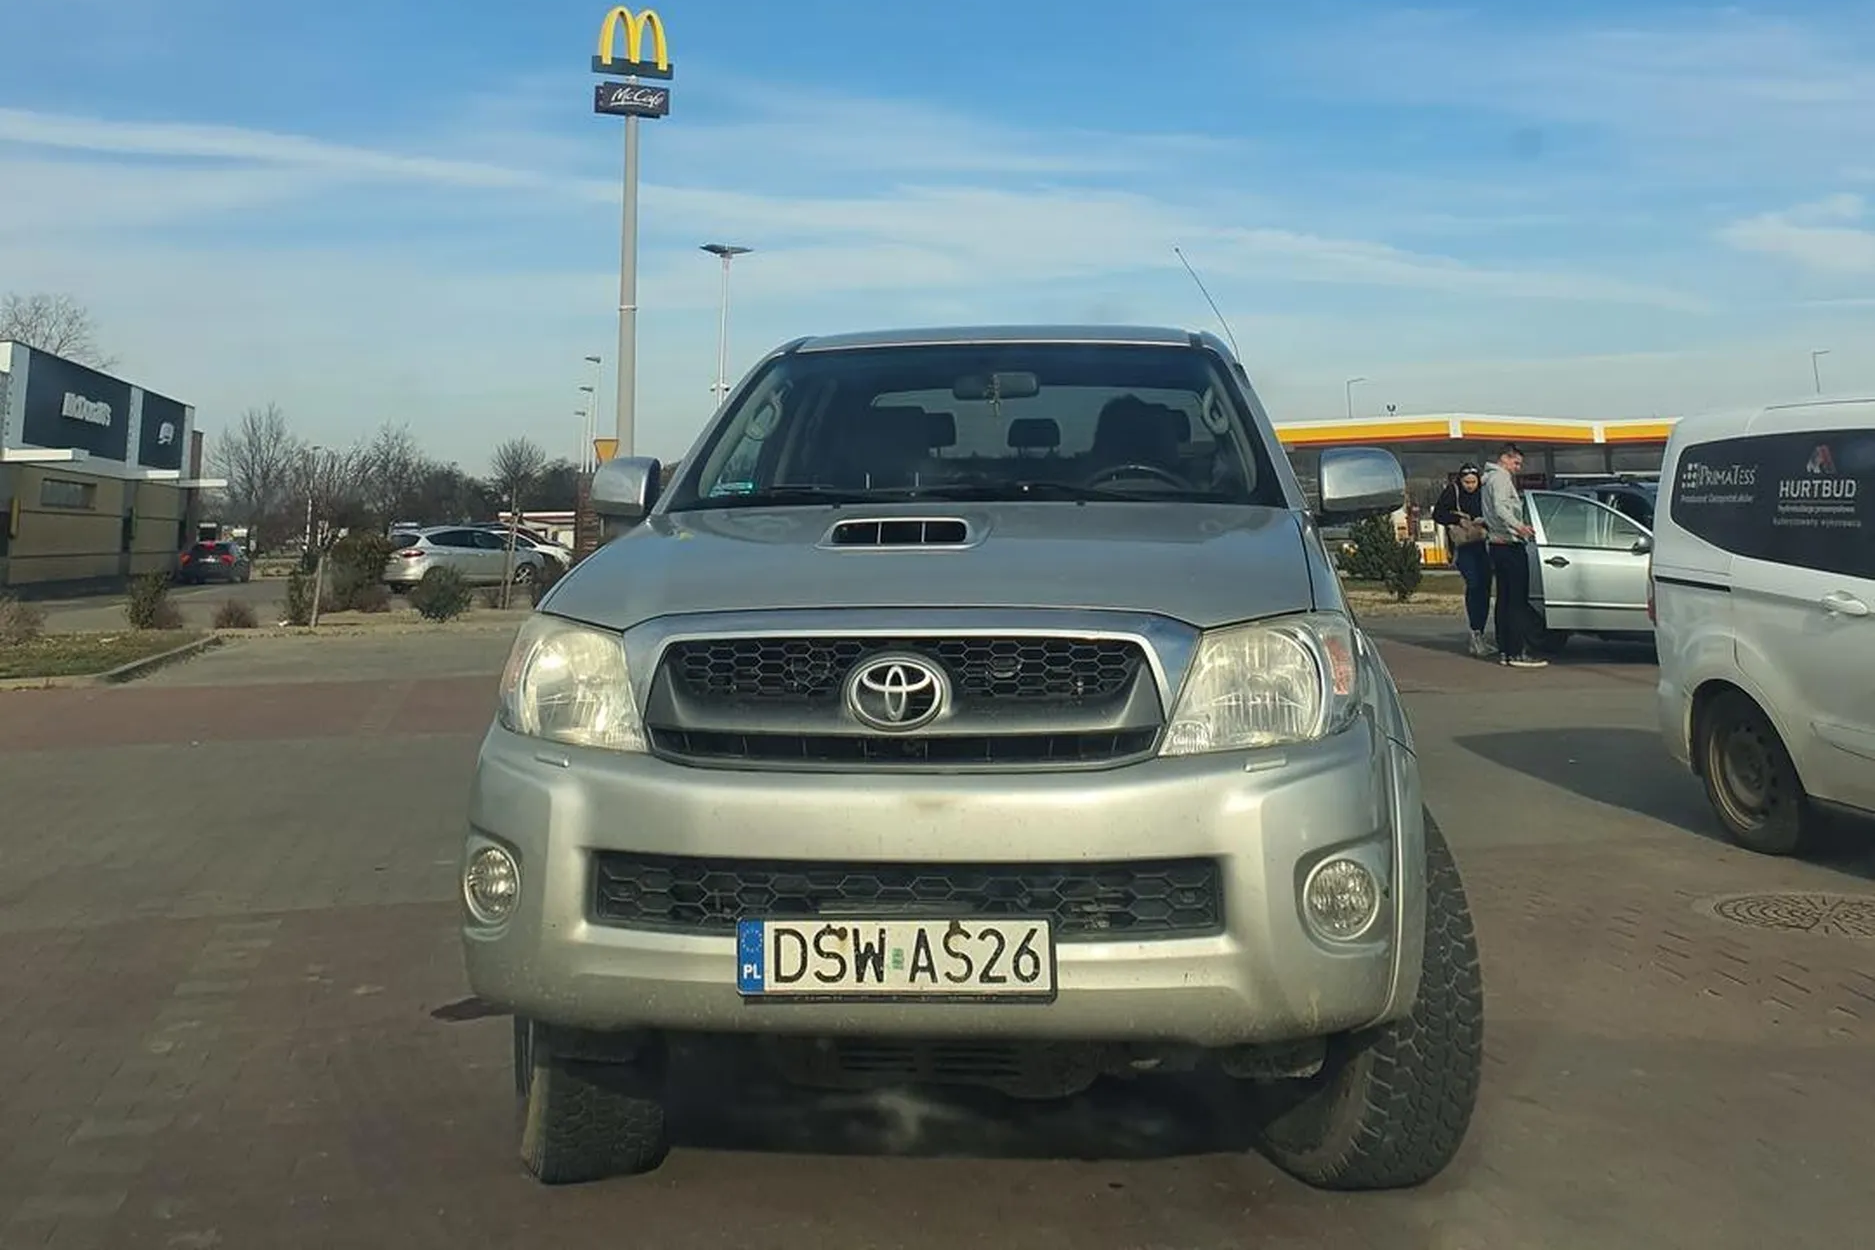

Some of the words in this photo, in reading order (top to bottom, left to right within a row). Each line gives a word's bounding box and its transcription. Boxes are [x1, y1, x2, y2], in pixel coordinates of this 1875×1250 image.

[1779, 479, 1857, 498] HURTBUD
[773, 927, 887, 984] DSW
[908, 927, 1041, 984] AS26
[743, 965, 762, 980] PL
